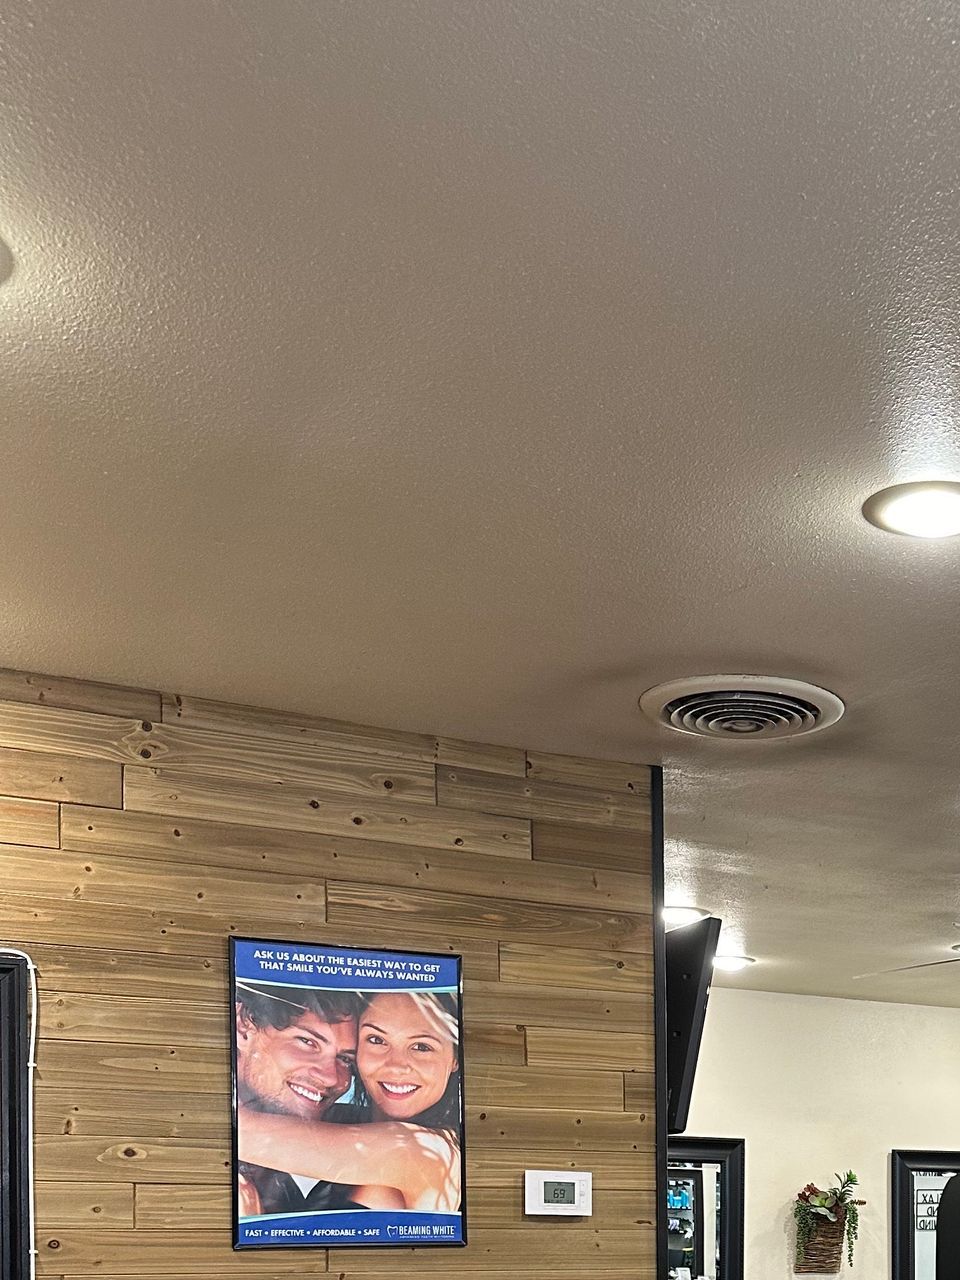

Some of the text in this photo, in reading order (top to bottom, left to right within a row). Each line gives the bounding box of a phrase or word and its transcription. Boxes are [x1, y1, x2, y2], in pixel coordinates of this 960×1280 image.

[253, 950, 441, 973] ASK US ABOUT THE EASIEST WAY TO GET
[259, 961, 436, 982] THAT SMILE YOU'VE ALWAYS WANTED
[553, 1188, 566, 1199] 69
[245, 1228, 380, 1237] FAST EFFECTIVE AFFORDABLE SAFE
[399, 1225, 455, 1236] BEAMING WHITE
